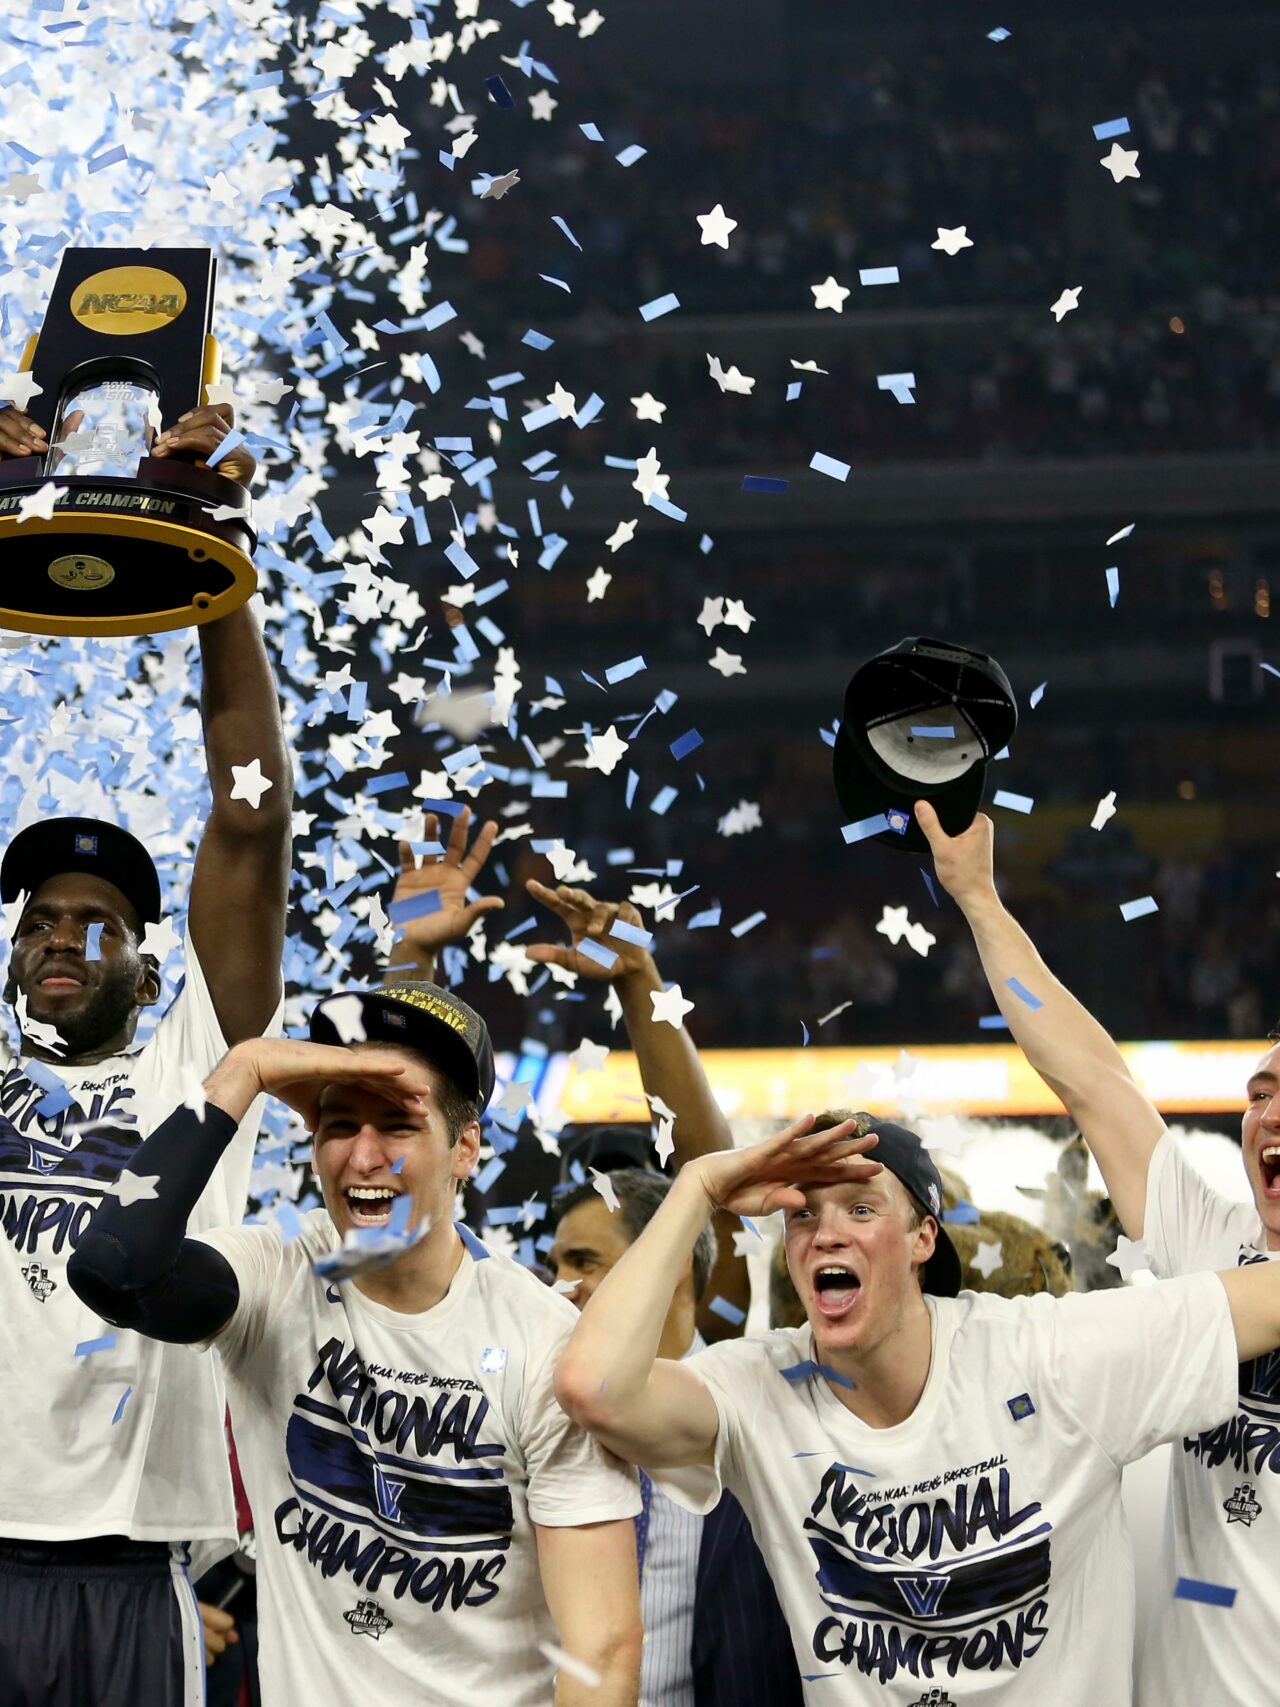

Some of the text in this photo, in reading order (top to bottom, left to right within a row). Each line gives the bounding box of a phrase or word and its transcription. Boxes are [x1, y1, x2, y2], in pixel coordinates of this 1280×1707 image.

[76, 293, 181, 317] NCAA
[75, 493, 175, 514] CHAMPION
[367, 1363, 392, 1379] NCAA
[883, 1486, 909, 1502] NCAA
[912, 1475, 942, 1496] MEN'S
[943, 1453, 1008, 1486] BASKETBALL
[811, 1462, 1042, 1561] NATIONAL
[1225, 1502, 1259, 1513] FINAL FOUR
[274, 1496, 507, 1612] CHAMPIONS
[894, 1576, 951, 1618] V
[347, 1612, 389, 1626] FINAL FOUR
[813, 1599, 1049, 1685] CHAMPIONS
